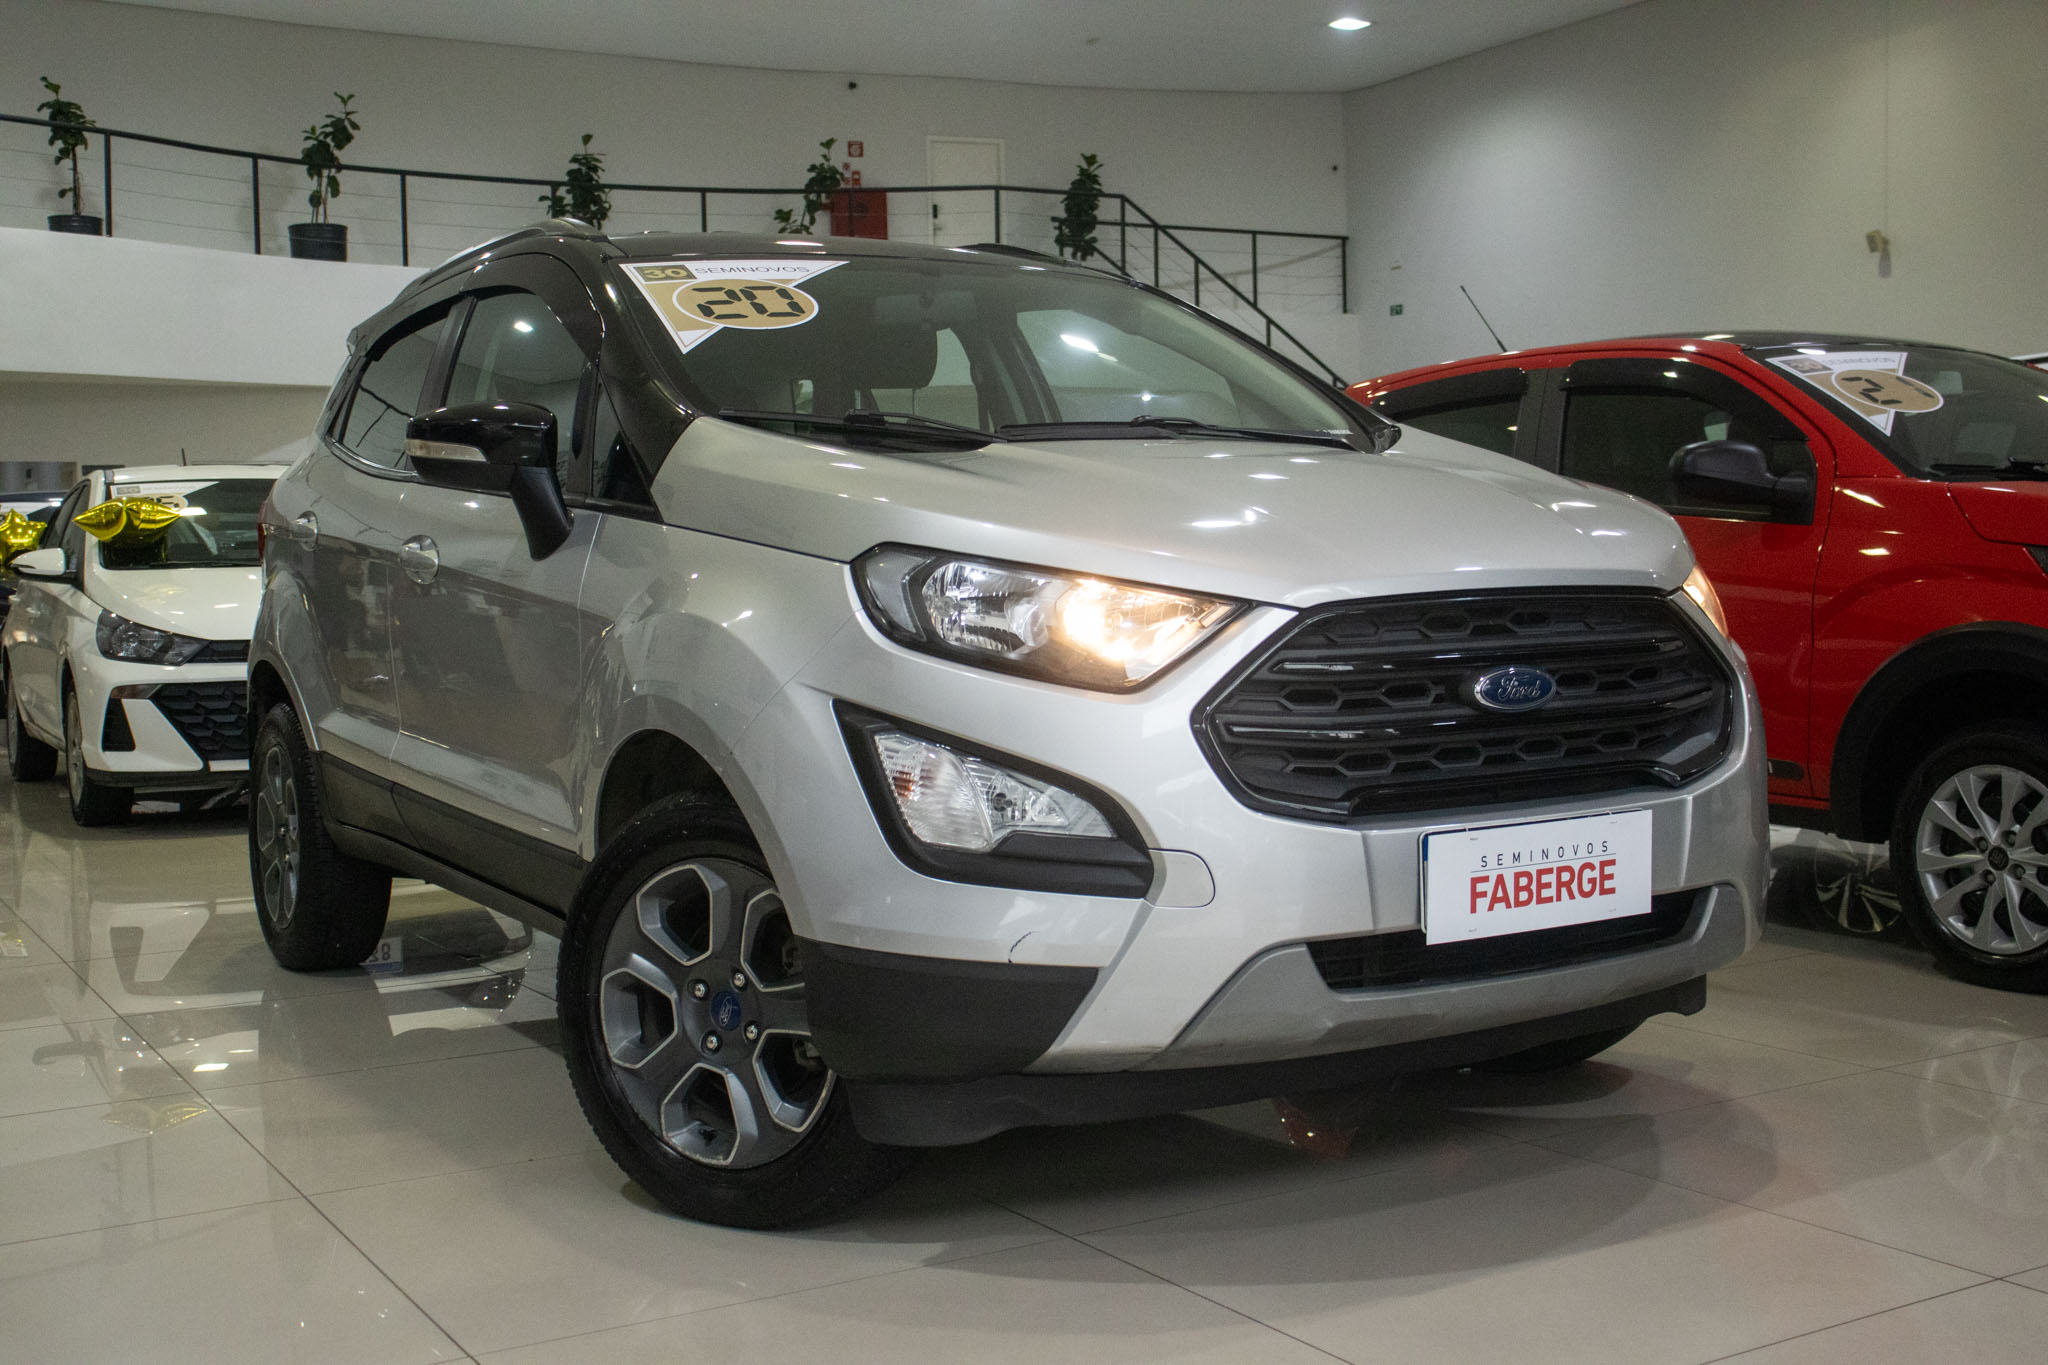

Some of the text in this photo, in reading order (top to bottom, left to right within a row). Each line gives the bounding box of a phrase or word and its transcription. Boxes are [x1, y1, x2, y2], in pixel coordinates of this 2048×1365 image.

[643, 265, 810, 279] 30 SEMINOVOS
[691, 286, 806, 319] 20
[1498, 675, 1541, 700] Ford
[1480, 840, 1609, 868] SEMINOVOS
[1470, 858, 1616, 914] FABERGE
